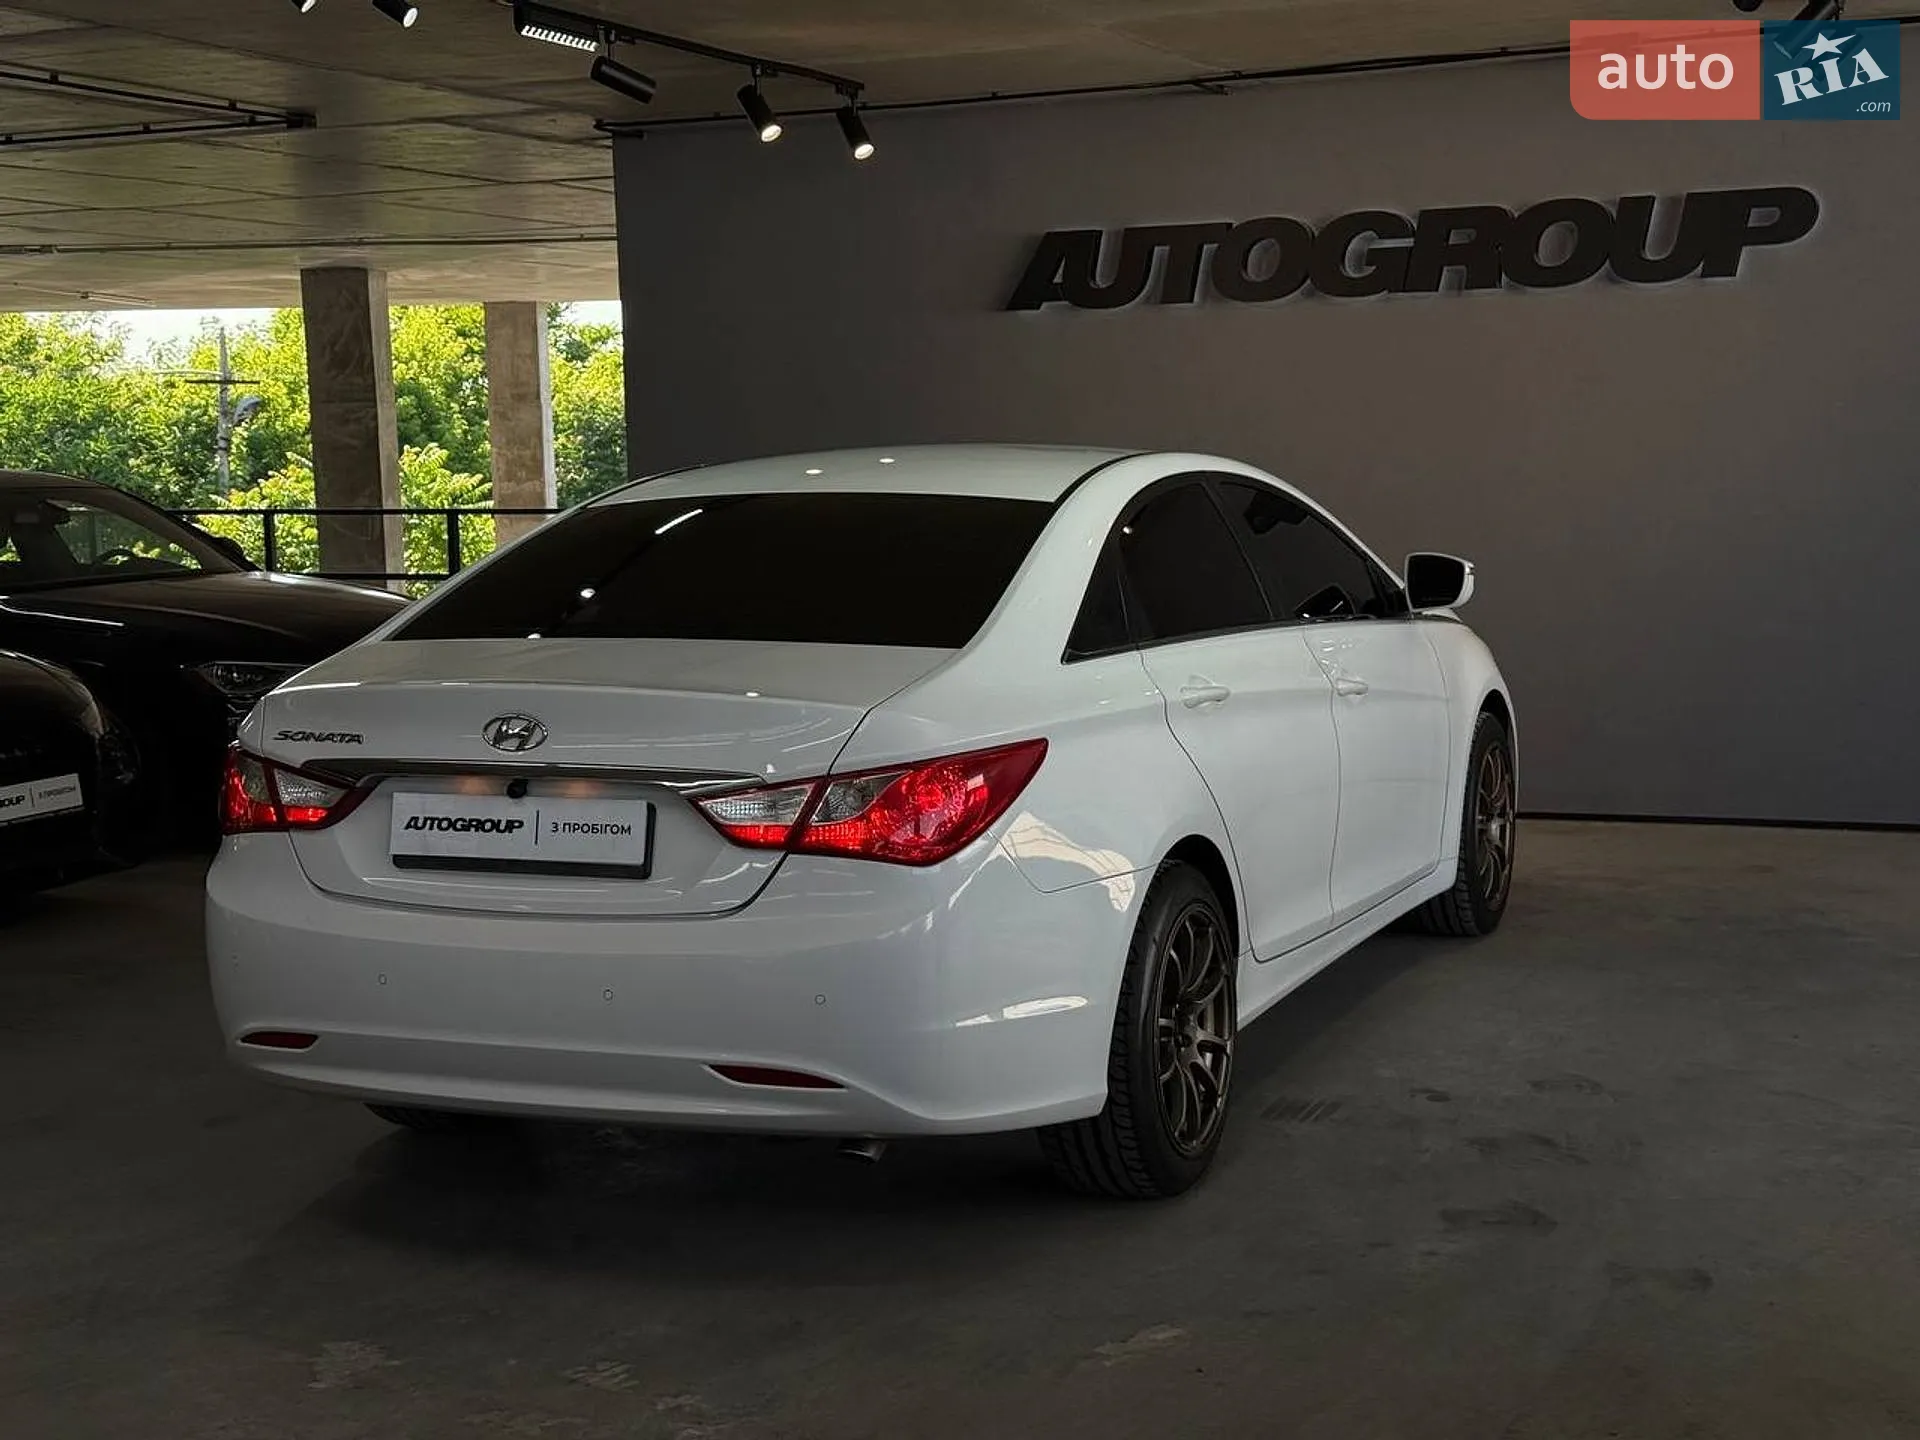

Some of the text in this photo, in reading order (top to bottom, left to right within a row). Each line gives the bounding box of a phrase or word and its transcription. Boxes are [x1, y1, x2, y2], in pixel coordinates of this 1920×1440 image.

[1006, 186, 1820, 312] AUTOGROUP
[273, 730, 364, 745] SONATA
[404, 815, 525, 834] AUTOGROUP
[563, 821, 632, 836] ПРОБІГОМ
